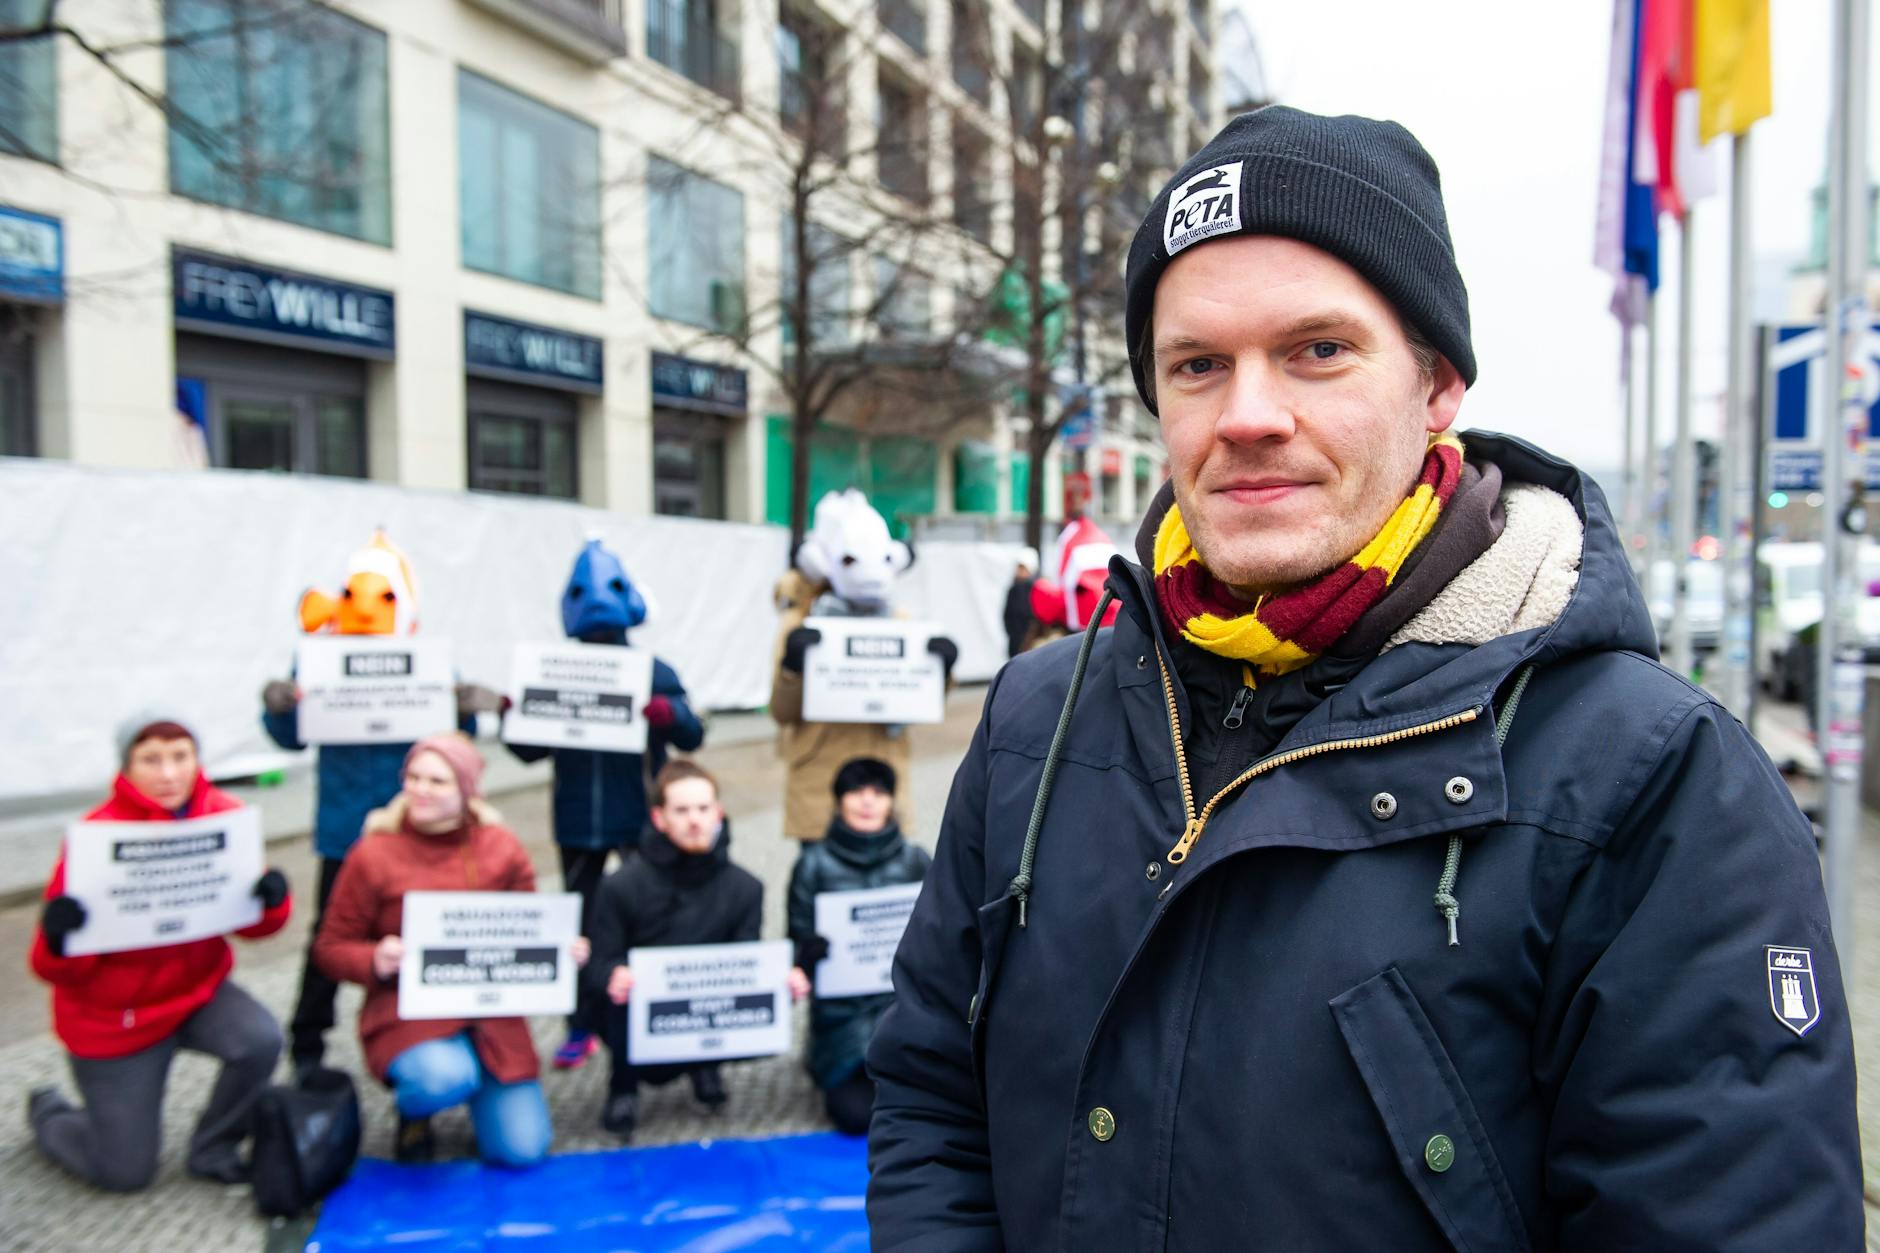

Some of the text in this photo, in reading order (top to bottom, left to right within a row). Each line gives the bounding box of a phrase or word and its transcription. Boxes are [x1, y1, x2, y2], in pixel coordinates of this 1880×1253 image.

[1170, 217, 1235, 249] stoppt tierquälerei!
[1774, 953, 1803, 968] derbe
